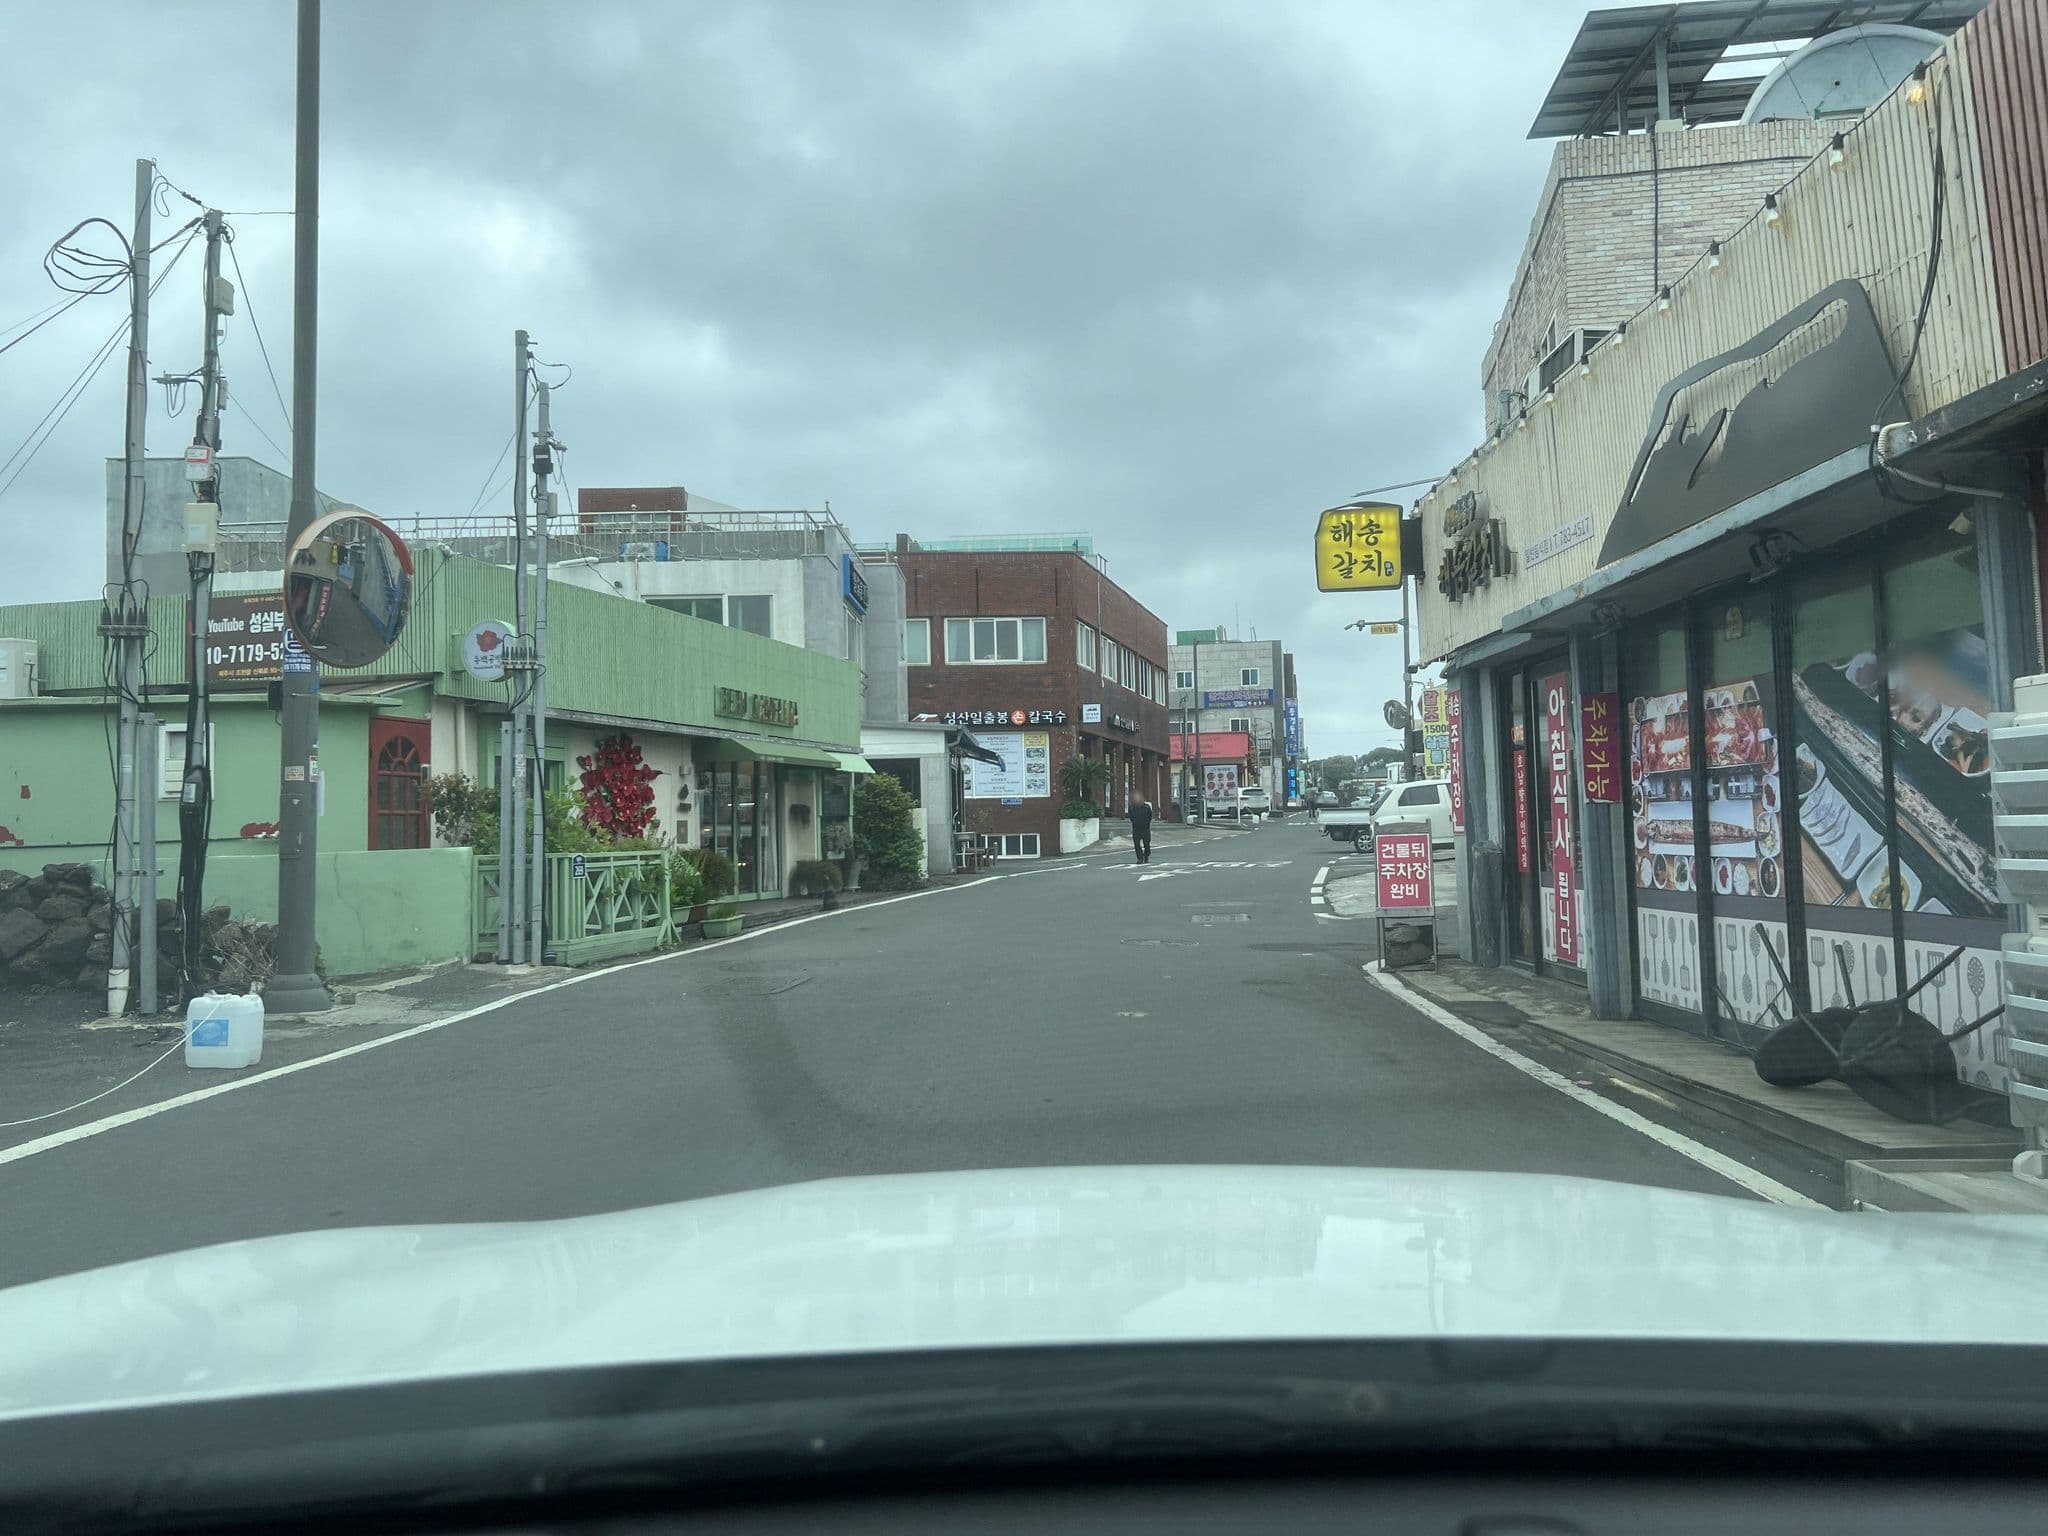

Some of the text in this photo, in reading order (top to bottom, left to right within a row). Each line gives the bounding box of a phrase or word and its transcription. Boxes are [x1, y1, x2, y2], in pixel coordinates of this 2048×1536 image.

[1330, 518, 1384, 549] 해송
[1331, 549, 1383, 579] 갈치
[207, 616, 245, 633] YouTube
[944, 710, 1009, 726] 성산일출봉
[1028, 710, 1067, 725] 칼국수
[1583, 698, 1610, 798] 주차가능
[1450, 724, 1462, 809] 주차장
[1549, 686, 1572, 955] 아침식사 됩니다
[1381, 842, 1425, 858] 건물뒤
[1381, 862, 1428, 880] 주차장
[1390, 883, 1419, 899] 완비
